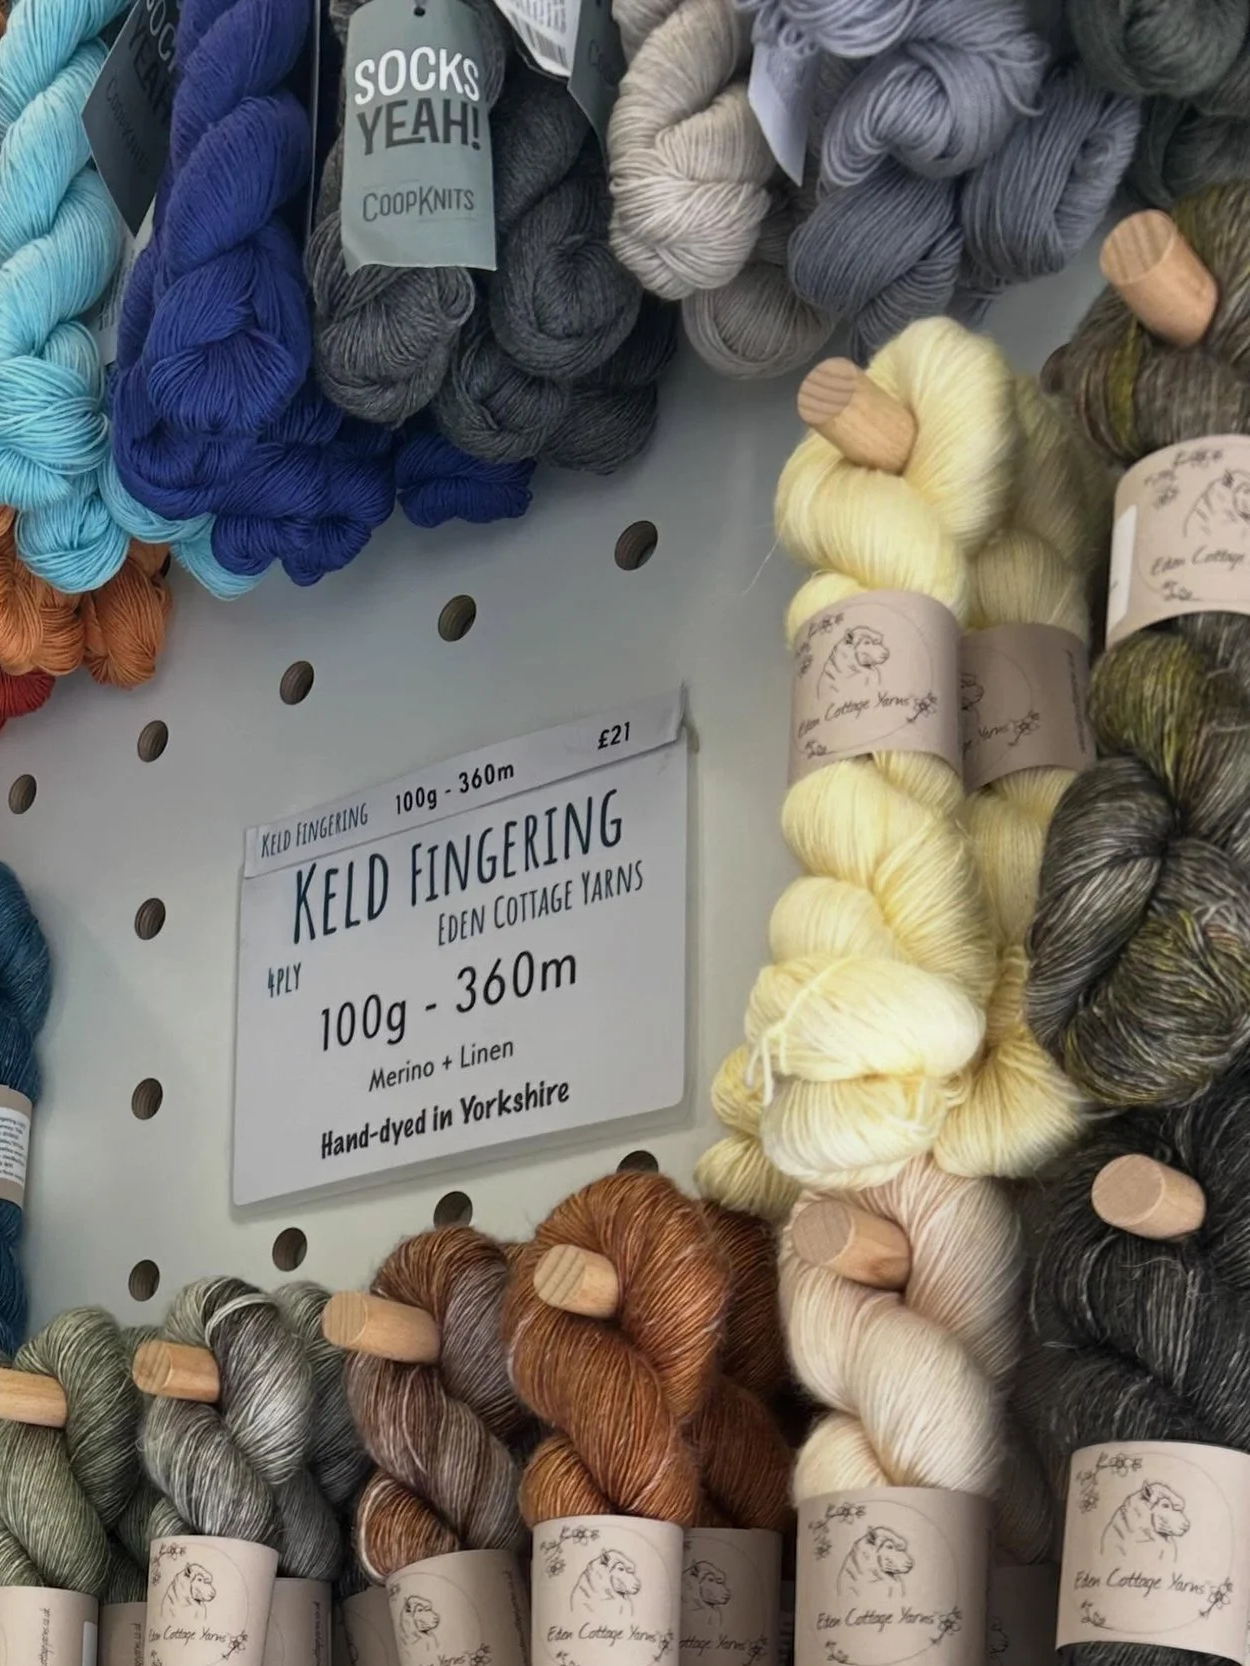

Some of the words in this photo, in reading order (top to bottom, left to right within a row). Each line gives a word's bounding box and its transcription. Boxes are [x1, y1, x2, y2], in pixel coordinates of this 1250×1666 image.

[354, 46, 480, 106] SOCKS
[356, 97, 482, 155] YEAH!
[1191, 544, 1245, 572] Cottage
[824, 700, 870, 721] Cottage
[874, 692, 910, 707] Yarns
[261, 827, 291, 859] KELD
[295, 803, 369, 847] FINGERING
[395, 786, 437, 815] 100g
[458, 761, 514, 795] 360m
[597, 721, 630, 750] £21
[293, 851, 390, 945] KELD
[409, 788, 624, 907] FINGERING
[437, 904, 486, 947] EDEN
[493, 879, 573, 930] COTTAGE
[580, 860, 644, 907] YARNS
[267, 961, 302, 999] 4PLY
[320, 994, 408, 1052] 100g
[455, 951, 577, 1014] 360m
[368, 1058, 435, 1094] Merino
[460, 1039, 514, 1070] Linen
[321, 1109, 427, 1160] Hand-dyed
[432, 1102, 453, 1132] in
[460, 1078, 571, 1126] Yorkshire
[1074, 1570, 1101, 1589] Eden
[1106, 1568, 1162, 1598] Cottage
[1169, 1572, 1205, 1595] Yarns
[163, 1625, 196, 1646] Cottage
[201, 1626, 227, 1642] Yarns
[547, 1625, 573, 1642] Eden
[578, 1622, 624, 1647] Cottage
[627, 1623, 657, 1643] Yarns
[816, 1612, 841, 1630] Eden
[844, 1607, 894, 1633] Cottage
[897, 1606, 935, 1624] Yarns
[678, 1635, 711, 1657] ottage
